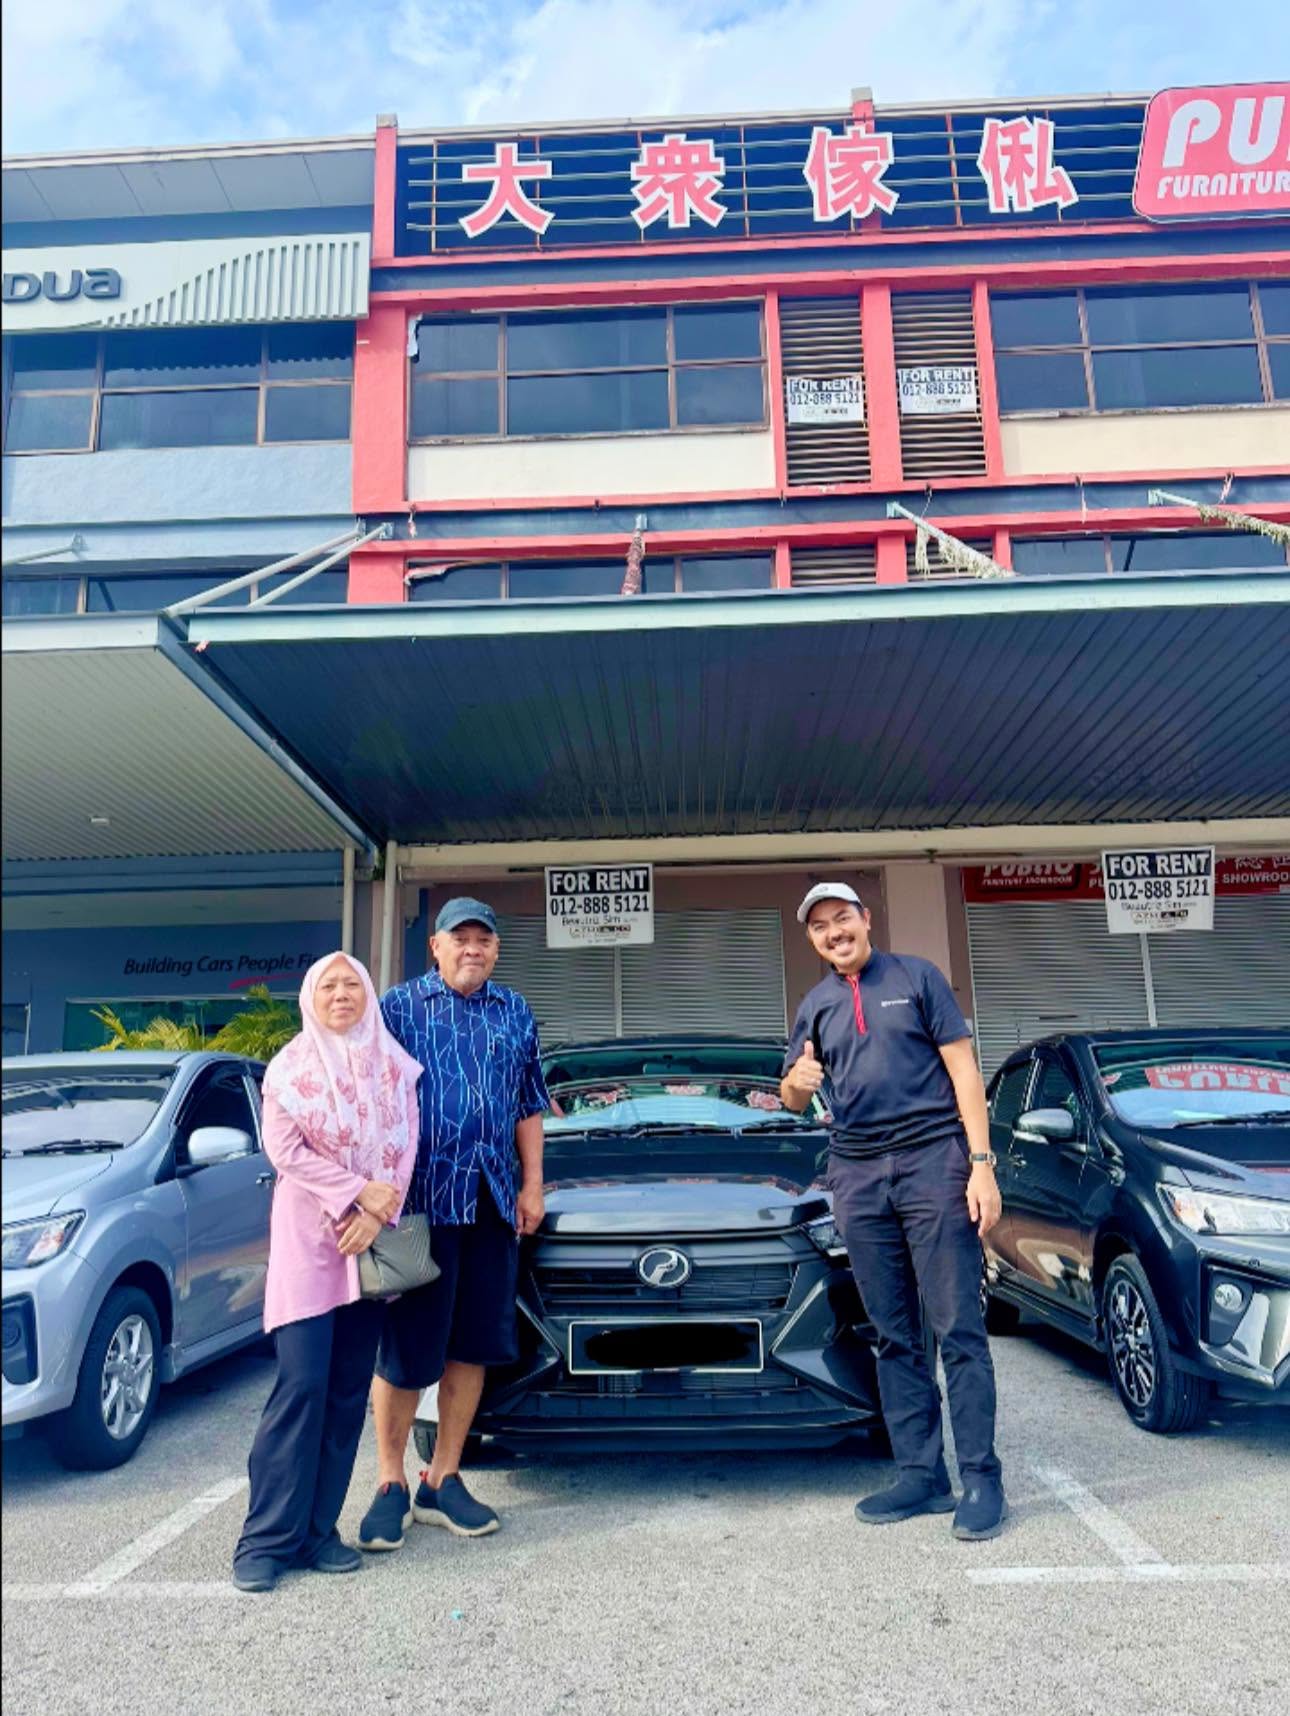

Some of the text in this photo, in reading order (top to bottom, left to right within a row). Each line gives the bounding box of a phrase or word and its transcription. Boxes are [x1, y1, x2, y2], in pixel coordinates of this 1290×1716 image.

[1162, 96, 1290, 169] PU
[790, 378, 861, 392] FOR RENT
[903, 368, 972, 382] FOR RENT
[1109, 856, 1151, 876] FOR
[1156, 853, 1210, 875] RENT
[552, 869, 648, 893] FOR RENT
[1108, 879, 1210, 900] 012-888 5121
[550, 894, 649, 916] 012-888 5121
[123, 956, 192, 976] Building
[197, 955, 233, 972] Cars
[238, 952, 294, 974] People
